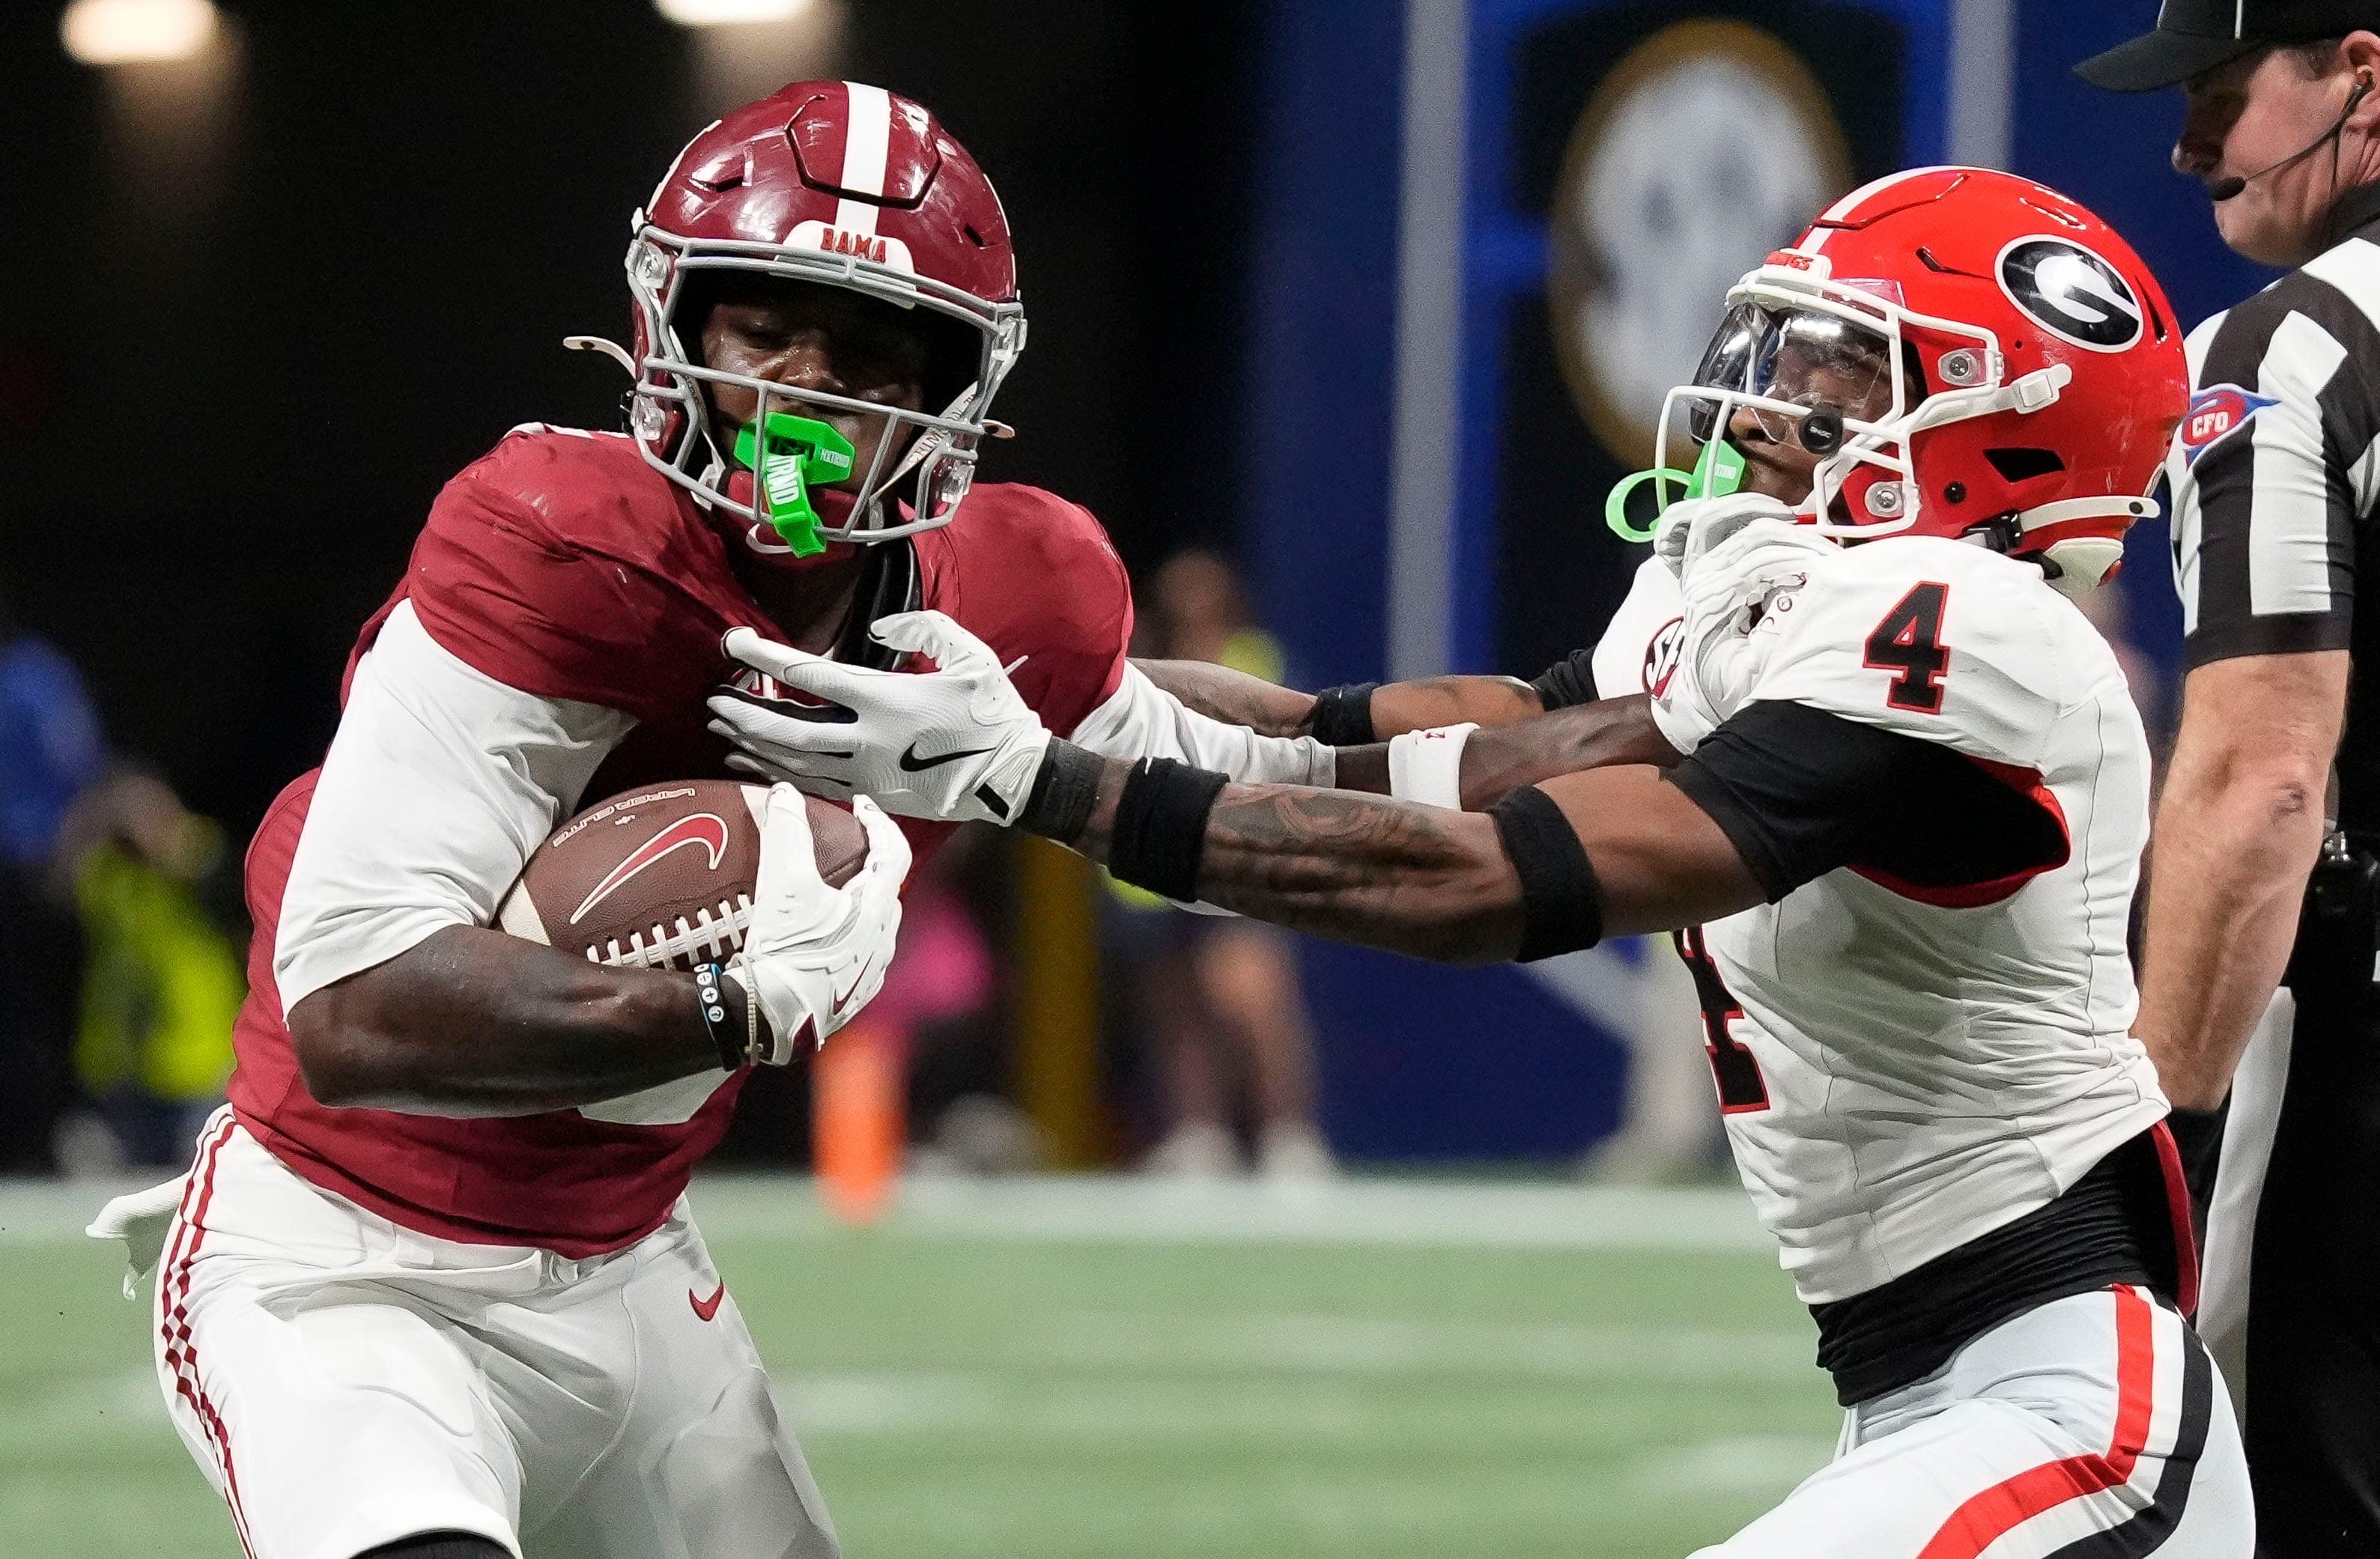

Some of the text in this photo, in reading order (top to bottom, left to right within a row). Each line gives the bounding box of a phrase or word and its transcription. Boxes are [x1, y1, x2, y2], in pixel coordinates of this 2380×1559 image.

[820, 228, 886, 263] BAMA
[2191, 411, 2229, 439] CFO
[1863, 580, 1951, 716] 4
